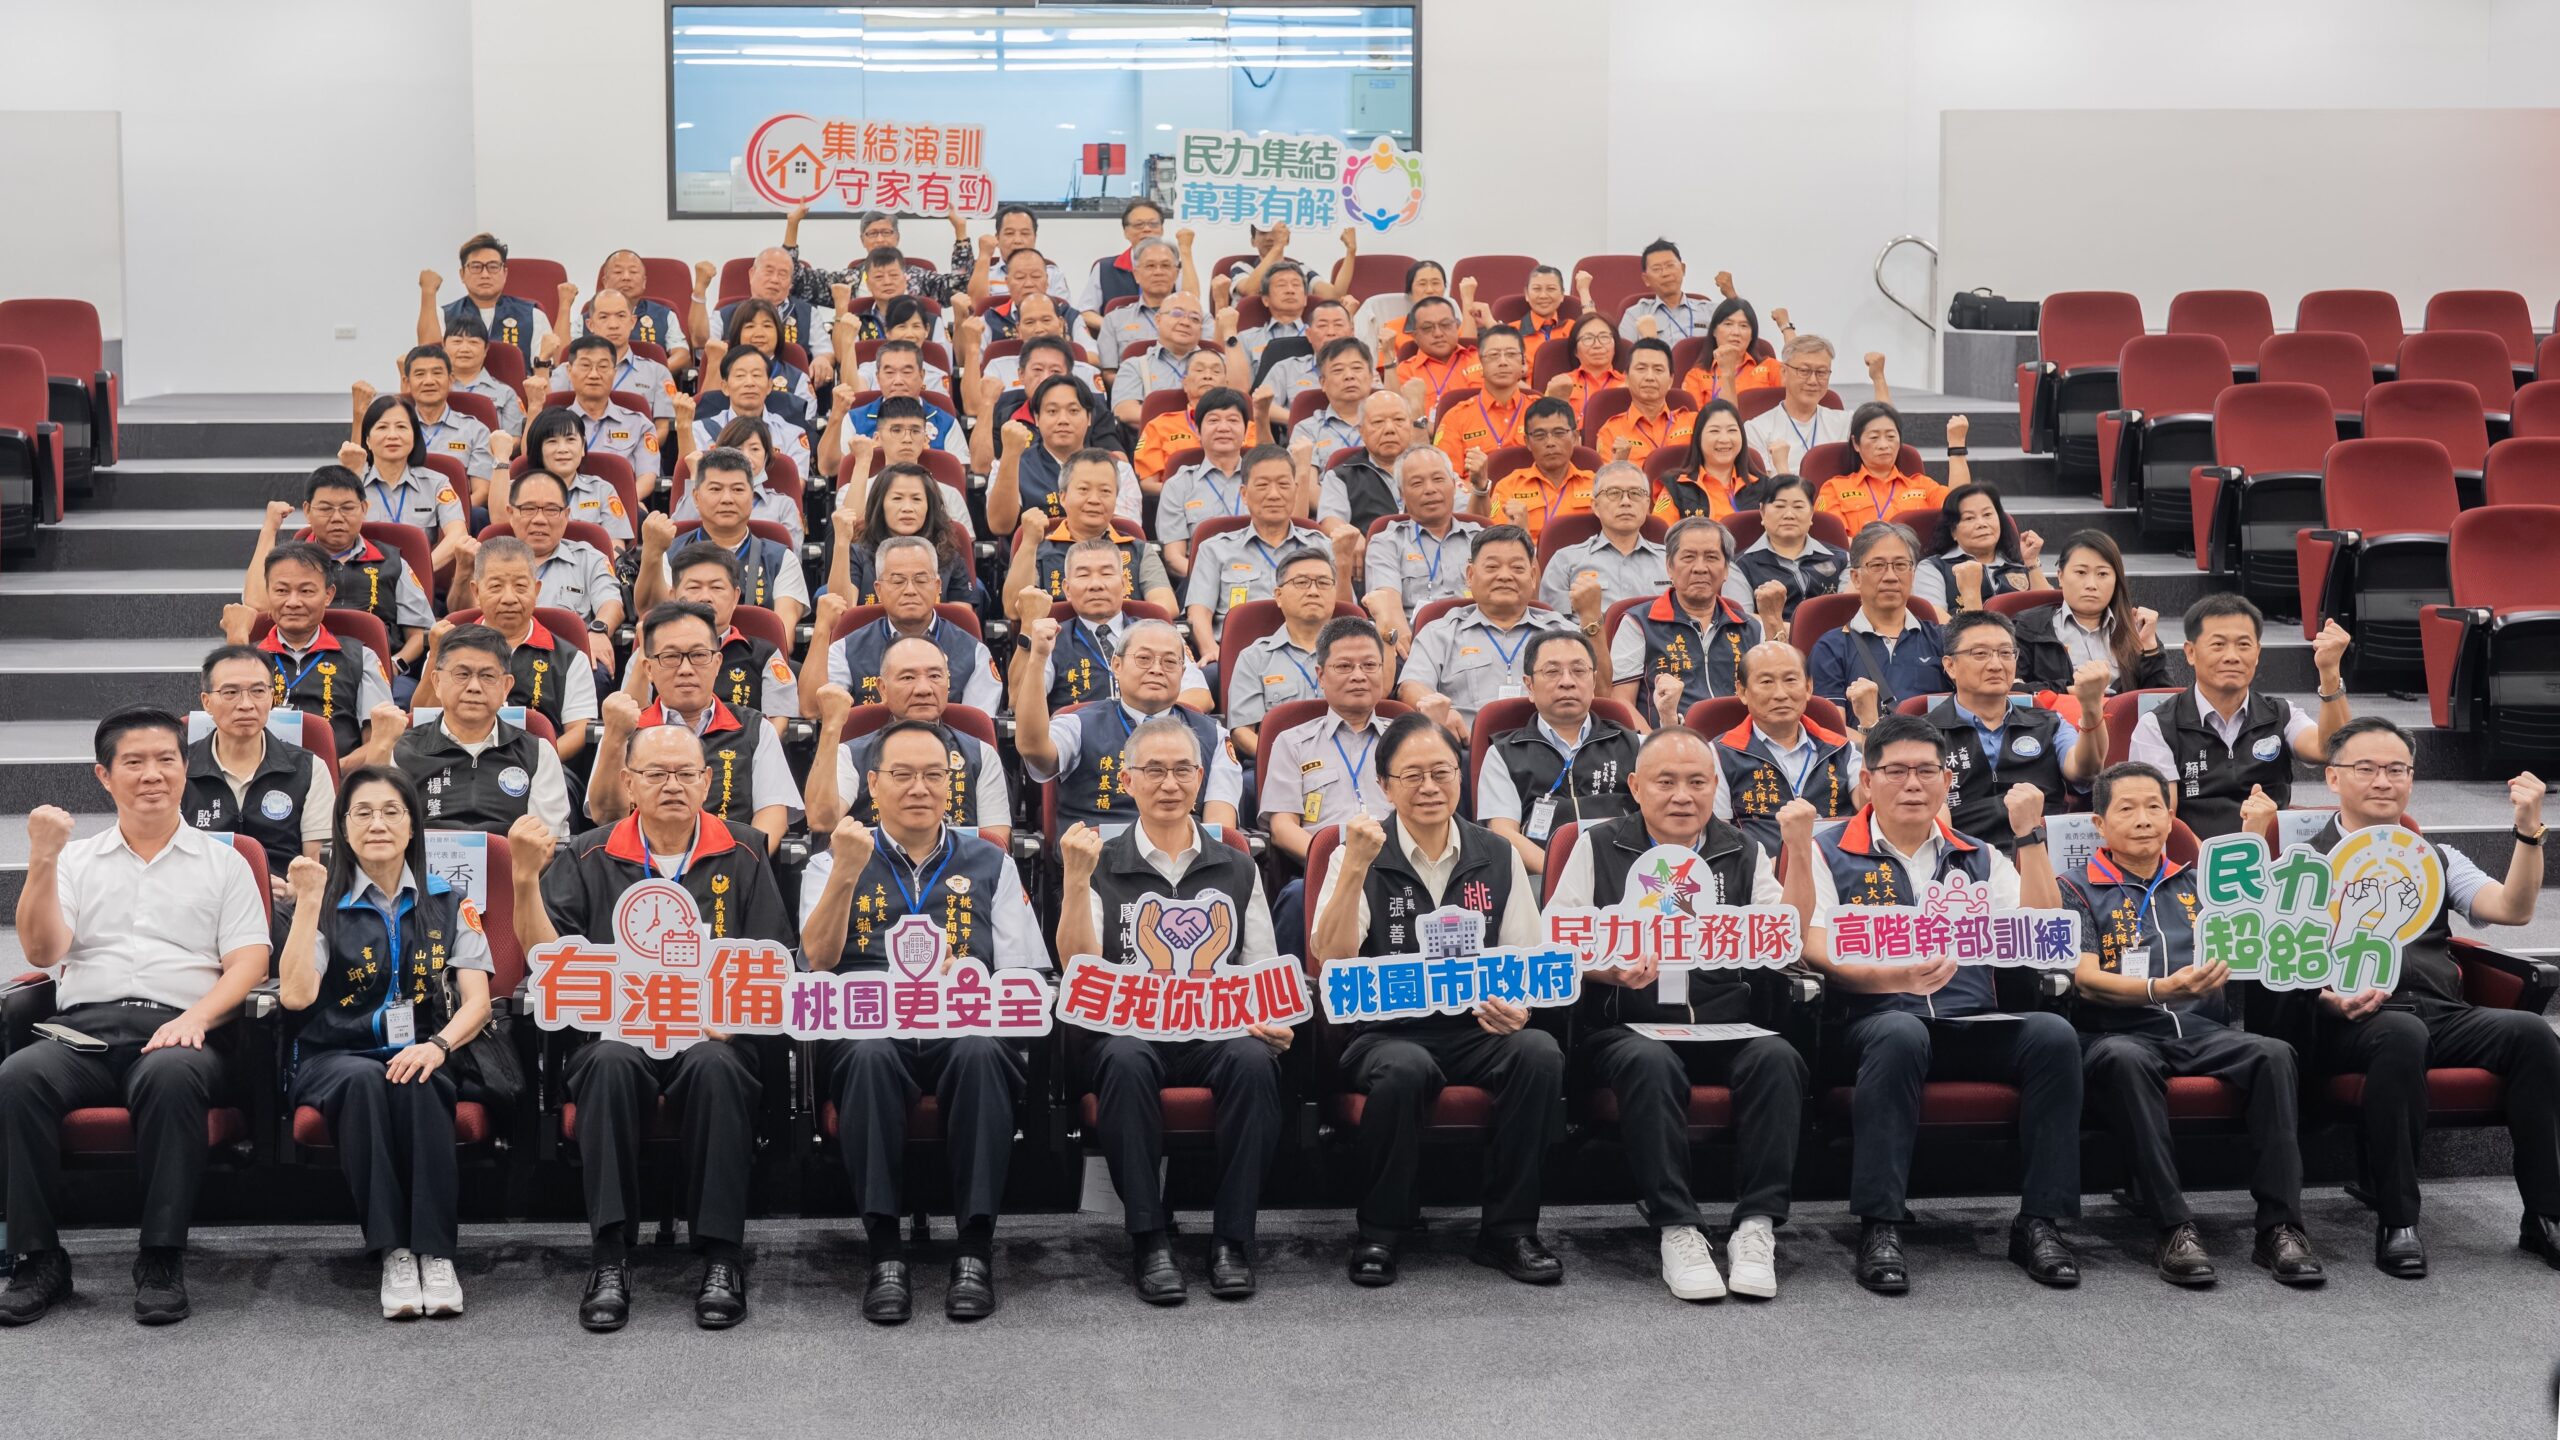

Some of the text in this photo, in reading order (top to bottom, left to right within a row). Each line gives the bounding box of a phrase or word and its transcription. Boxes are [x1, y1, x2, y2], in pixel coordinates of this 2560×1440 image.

[821, 121, 983, 169] 集結演訓
[1184, 135, 1338, 180] 民力集結
[834, 168, 993, 213] 守家有勁
[1181, 182, 1336, 227] 萬事有解
[1656, 657, 1669, 675] 王
[1096, 756, 1114, 810] 陳基福
[1403, 886, 1416, 910] 市長
[1865, 871, 1881, 906] 副大
[2208, 842, 2332, 912] 民力
[875, 882, 888, 922] 大隊長
[946, 894, 958, 945] 守望相助
[361, 946, 377, 974] 書記
[431, 943, 446, 978] 桃園
[1551, 912, 1795, 962] 民力任務隊
[2203, 914, 2393, 990] 超給力
[536, 945, 789, 1050] 有準備
[791, 967, 1044, 1031] 桃園更安全
[1064, 963, 1307, 1032] 有我你放心
[1327, 951, 1576, 1017] 桃園市政府
